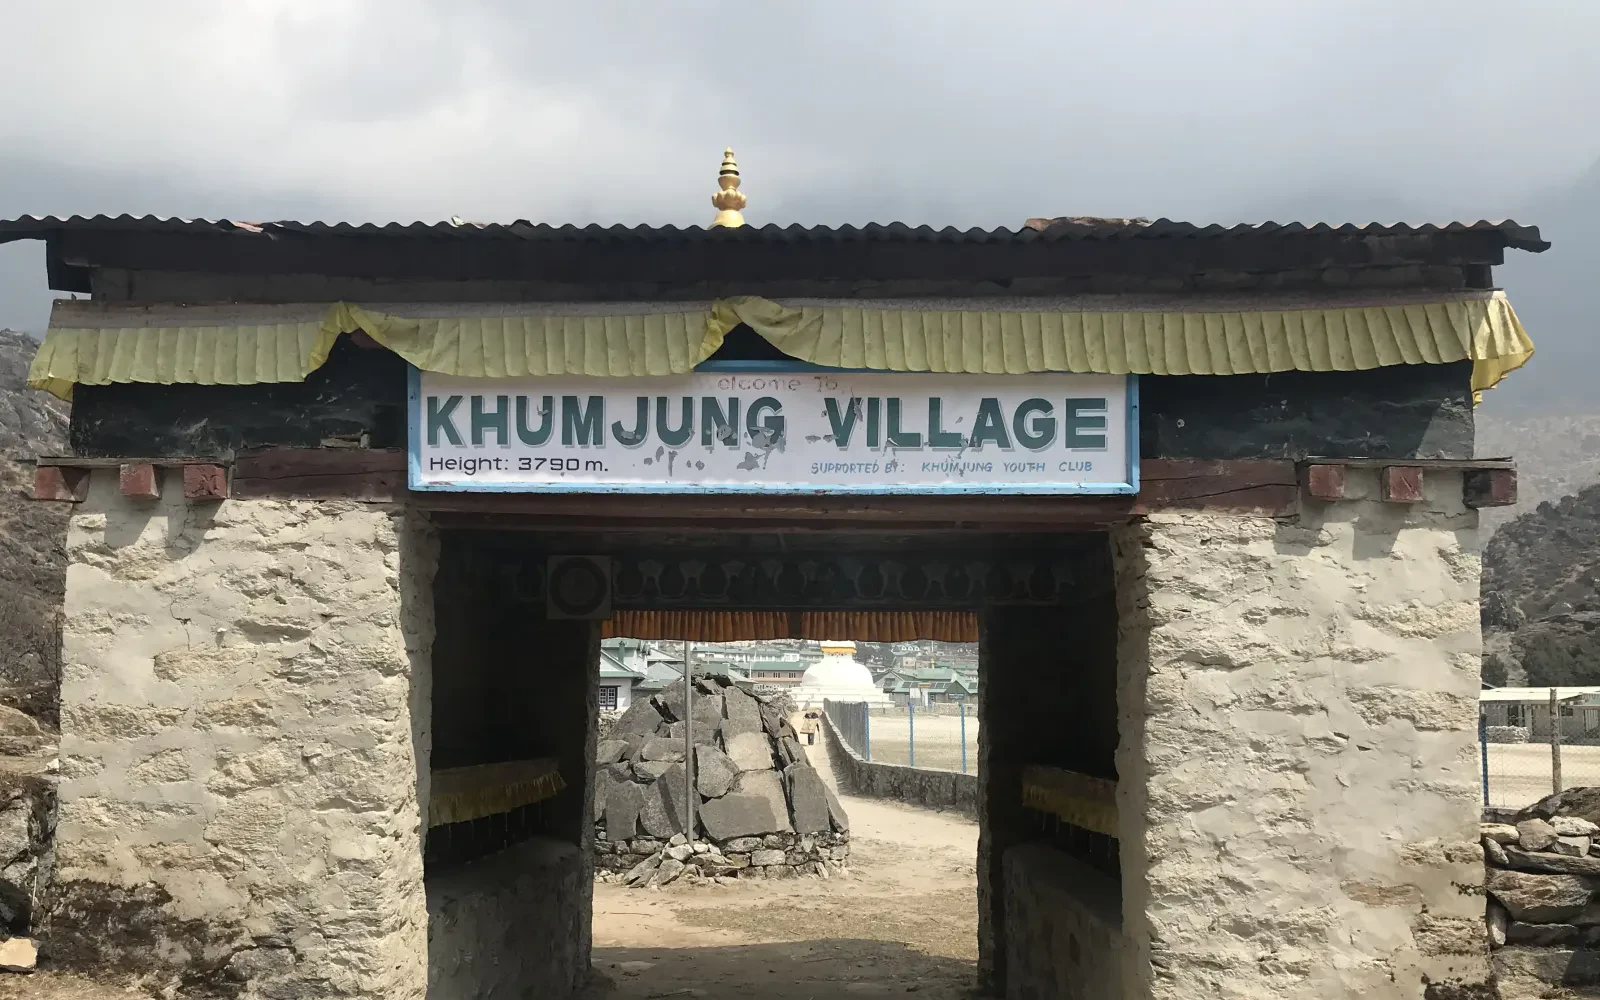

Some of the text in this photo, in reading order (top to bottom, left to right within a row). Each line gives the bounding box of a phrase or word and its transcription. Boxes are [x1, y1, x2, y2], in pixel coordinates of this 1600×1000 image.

[716, 376, 801, 391] elcome
[427, 395, 1107, 450] KHUMJUNG VILLAGE
[429, 456, 608, 475] Height: 3790 m.
[811, 462, 880, 474] SUPPORTED
[922, 461, 993, 474] KHUMJUNG
[1003, 462, 1046, 472] YOUTH
[1058, 461, 1093, 472] CLUB
